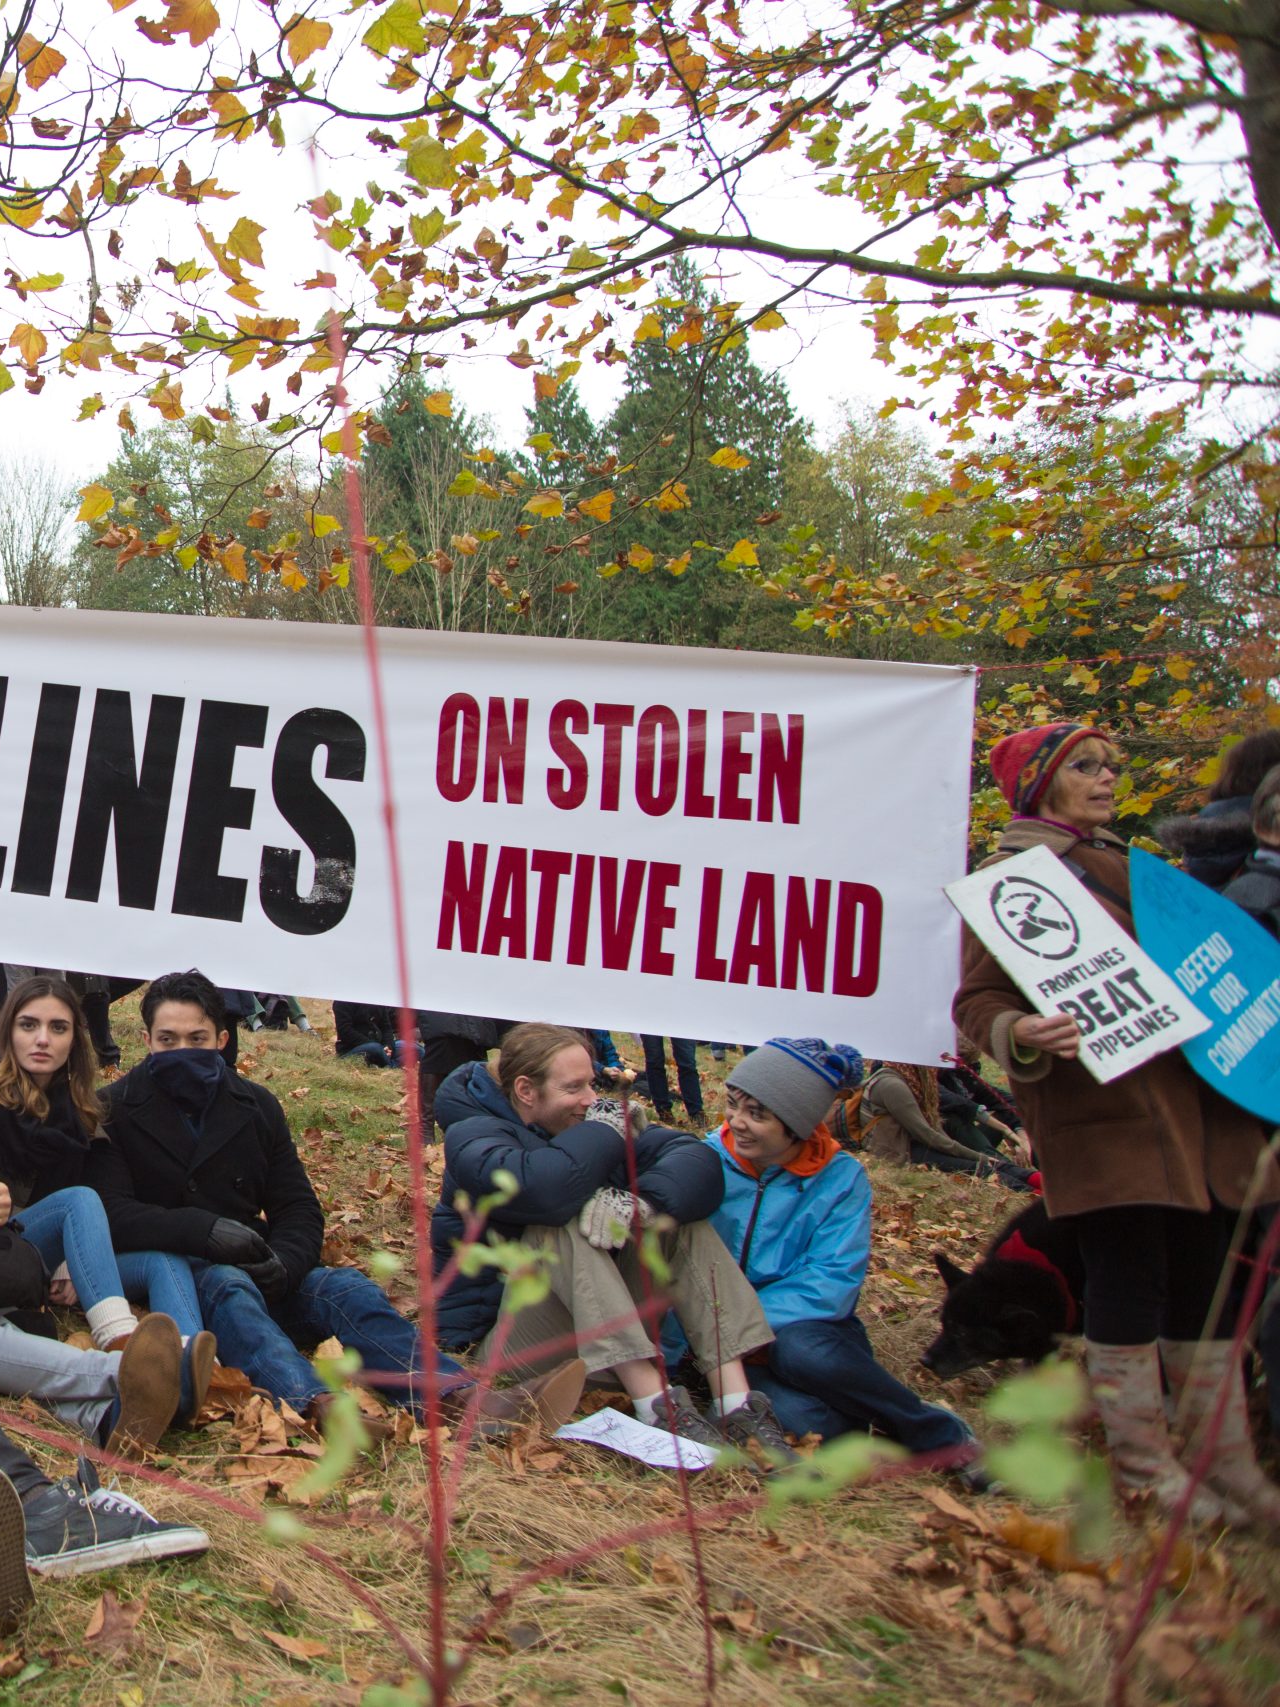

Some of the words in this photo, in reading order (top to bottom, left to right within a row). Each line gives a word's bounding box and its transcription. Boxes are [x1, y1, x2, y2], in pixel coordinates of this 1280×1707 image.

[435, 692, 529, 805] ON
[546, 698, 805, 825] STOLEN
[436, 840, 681, 976] NATIVE
[695, 867, 884, 998] LAND
[1036, 947, 1126, 998] FRONTLINES
[1174, 931, 1233, 996] DEFEND
[1209, 971, 1249, 1015] OUR
[1056, 967, 1155, 1037] BEAT
[1087, 1005, 1180, 1062] PIPELINES
